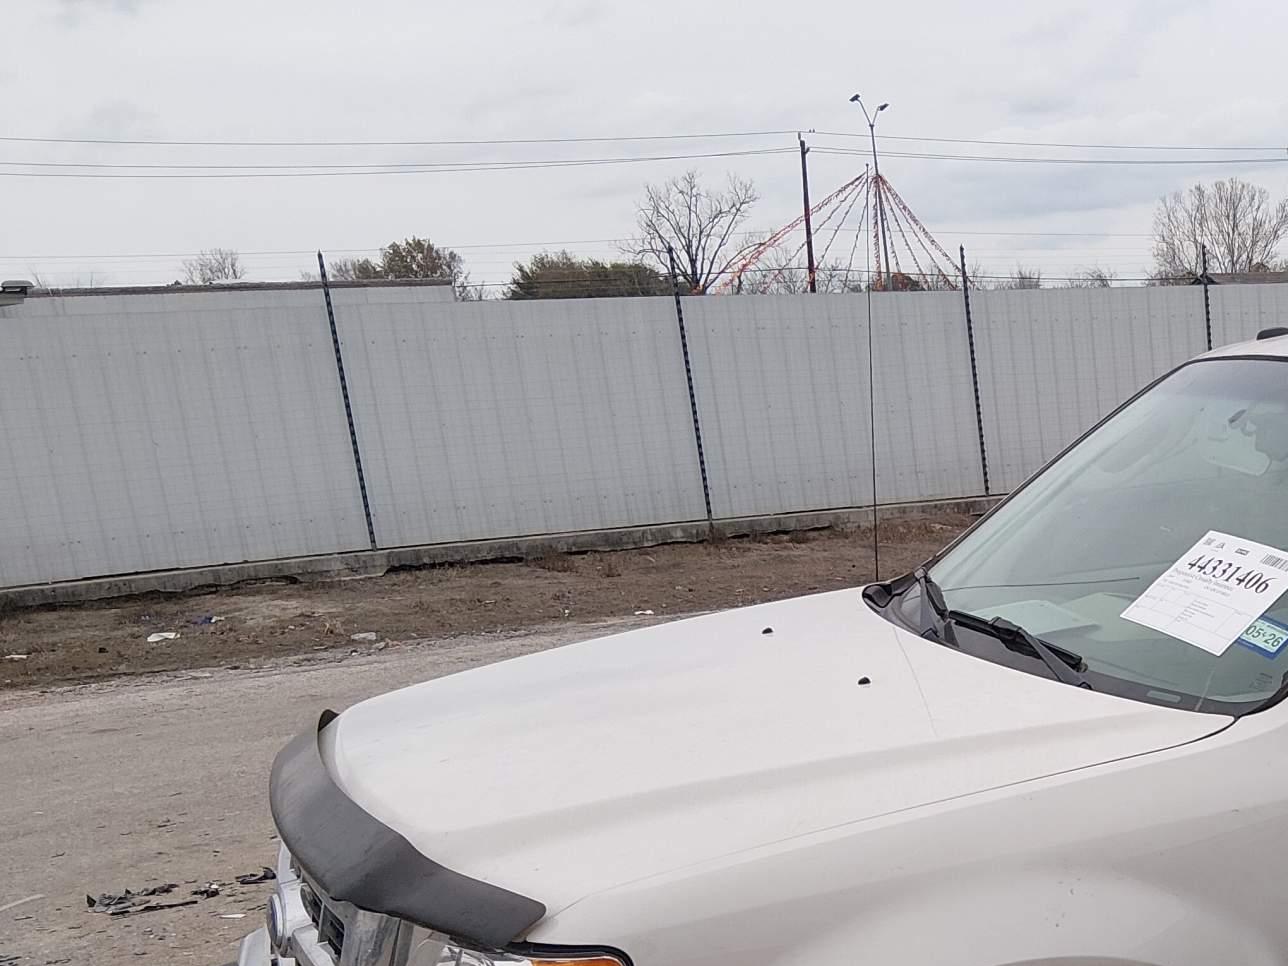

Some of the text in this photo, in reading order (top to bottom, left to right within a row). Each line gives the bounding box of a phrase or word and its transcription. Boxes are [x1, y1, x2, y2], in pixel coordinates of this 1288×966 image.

[1187, 554, 1278, 593] 44331406
[1245, 625, 1264, 638] 05
[1263, 633, 1284, 647] 26
